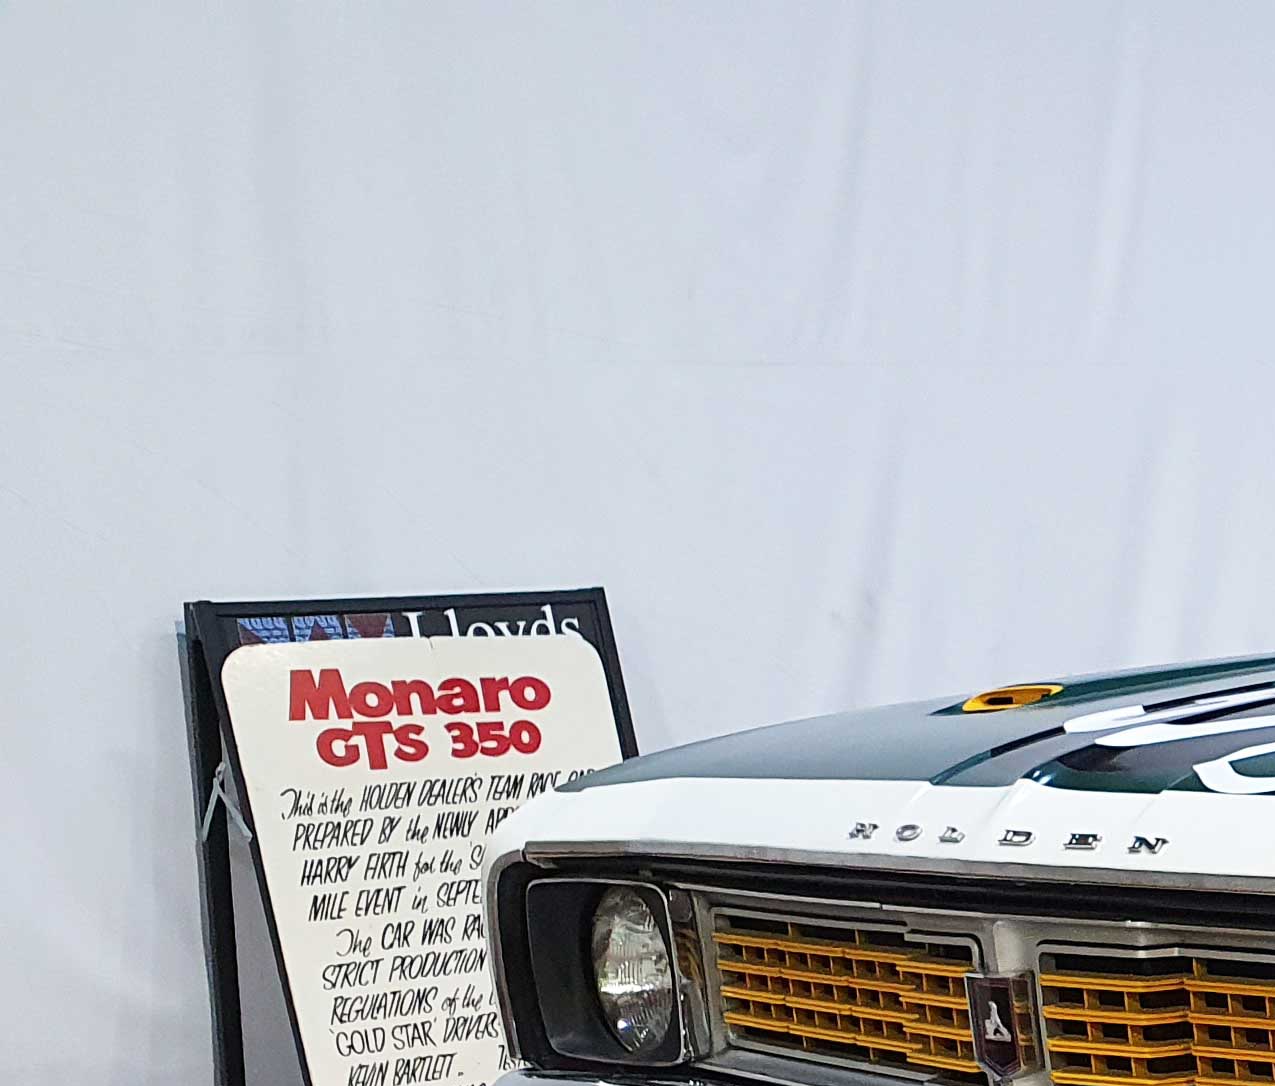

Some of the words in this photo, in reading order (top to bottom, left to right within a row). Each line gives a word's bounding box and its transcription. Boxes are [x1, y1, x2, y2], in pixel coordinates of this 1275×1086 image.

[289, 668, 552, 721] Monaro
[316, 720, 430, 770] GTS
[447, 719, 542, 759] 350
[359, 781, 417, 812] HOLDEN
[417, 772, 483, 806] DEALER'S
[486, 773, 525, 802] TEAM
[292, 818, 374, 851] PREPARED
[378, 815, 402, 844] BY
[405, 814, 429, 844] the
[432, 810, 479, 840] NEWLY
[848, 821, 1170, 855] HOLDEN
[300, 855, 361, 887] HARRY
[364, 850, 409, 881] FIRTH
[439, 849, 463, 876] the
[308, 890, 350, 922] MILE
[354, 885, 408, 917] EVENT
[336, 928, 372, 958] The
[381, 920, 415, 951] CAR
[421, 916, 456, 946] WAS
[322, 957, 385, 990] STRICT
[389, 948, 488, 982] PRODUCTION
[330, 986, 438, 1025] REGULATIONS
[441, 987, 460, 1015] of
[462, 984, 484, 1011] the
